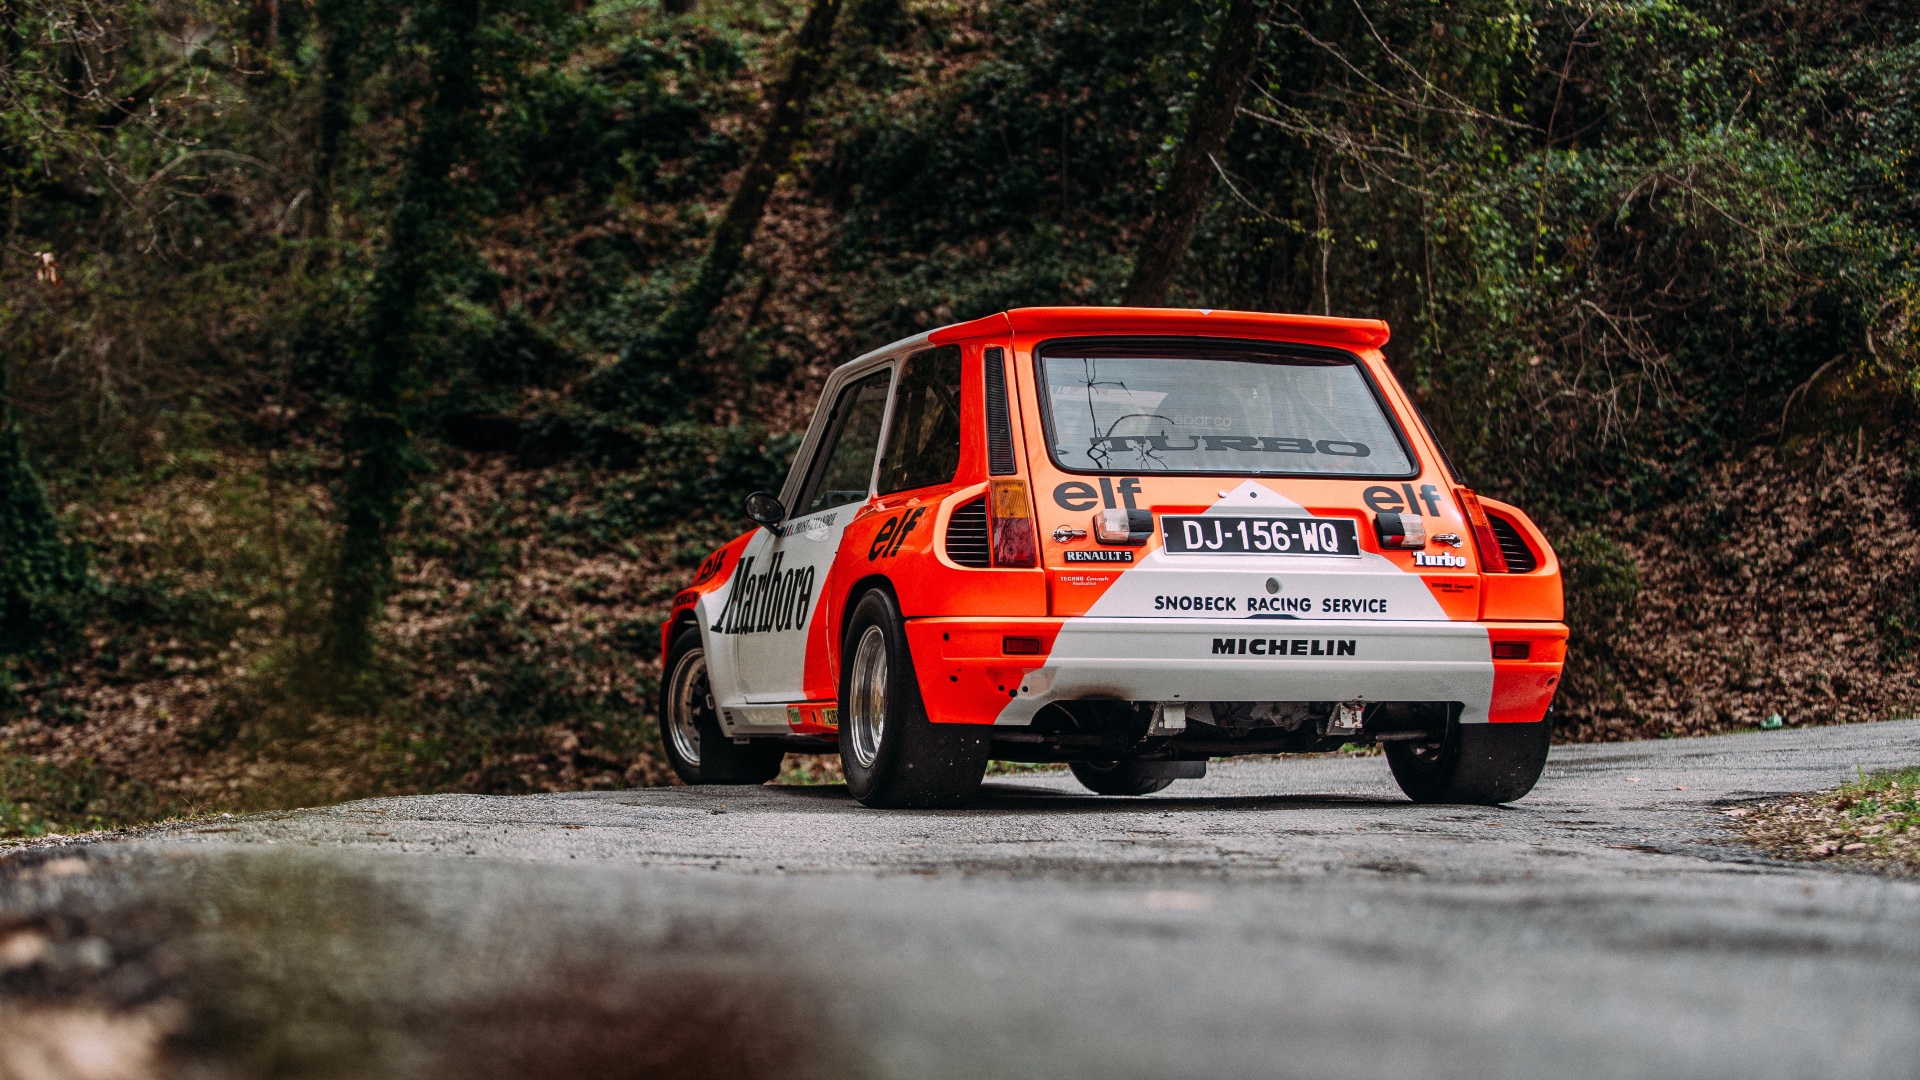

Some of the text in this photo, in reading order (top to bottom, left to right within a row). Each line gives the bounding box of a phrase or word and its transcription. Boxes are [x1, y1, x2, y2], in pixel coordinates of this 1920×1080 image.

[1090, 435, 1371, 458] TURBO
[1053, 477, 1142, 511] elf
[1362, 483, 1441, 518] elf
[868, 506, 926, 562] elf
[1182, 519, 1339, 553] DJ-156-WQ
[1067, 550, 1132, 562] RENAULT 5
[1412, 551, 1467, 568] Turbo
[1154, 595, 1388, 613] SNOBECK RACING SERVICE
[1211, 638, 1357, 656] MICHELIN
